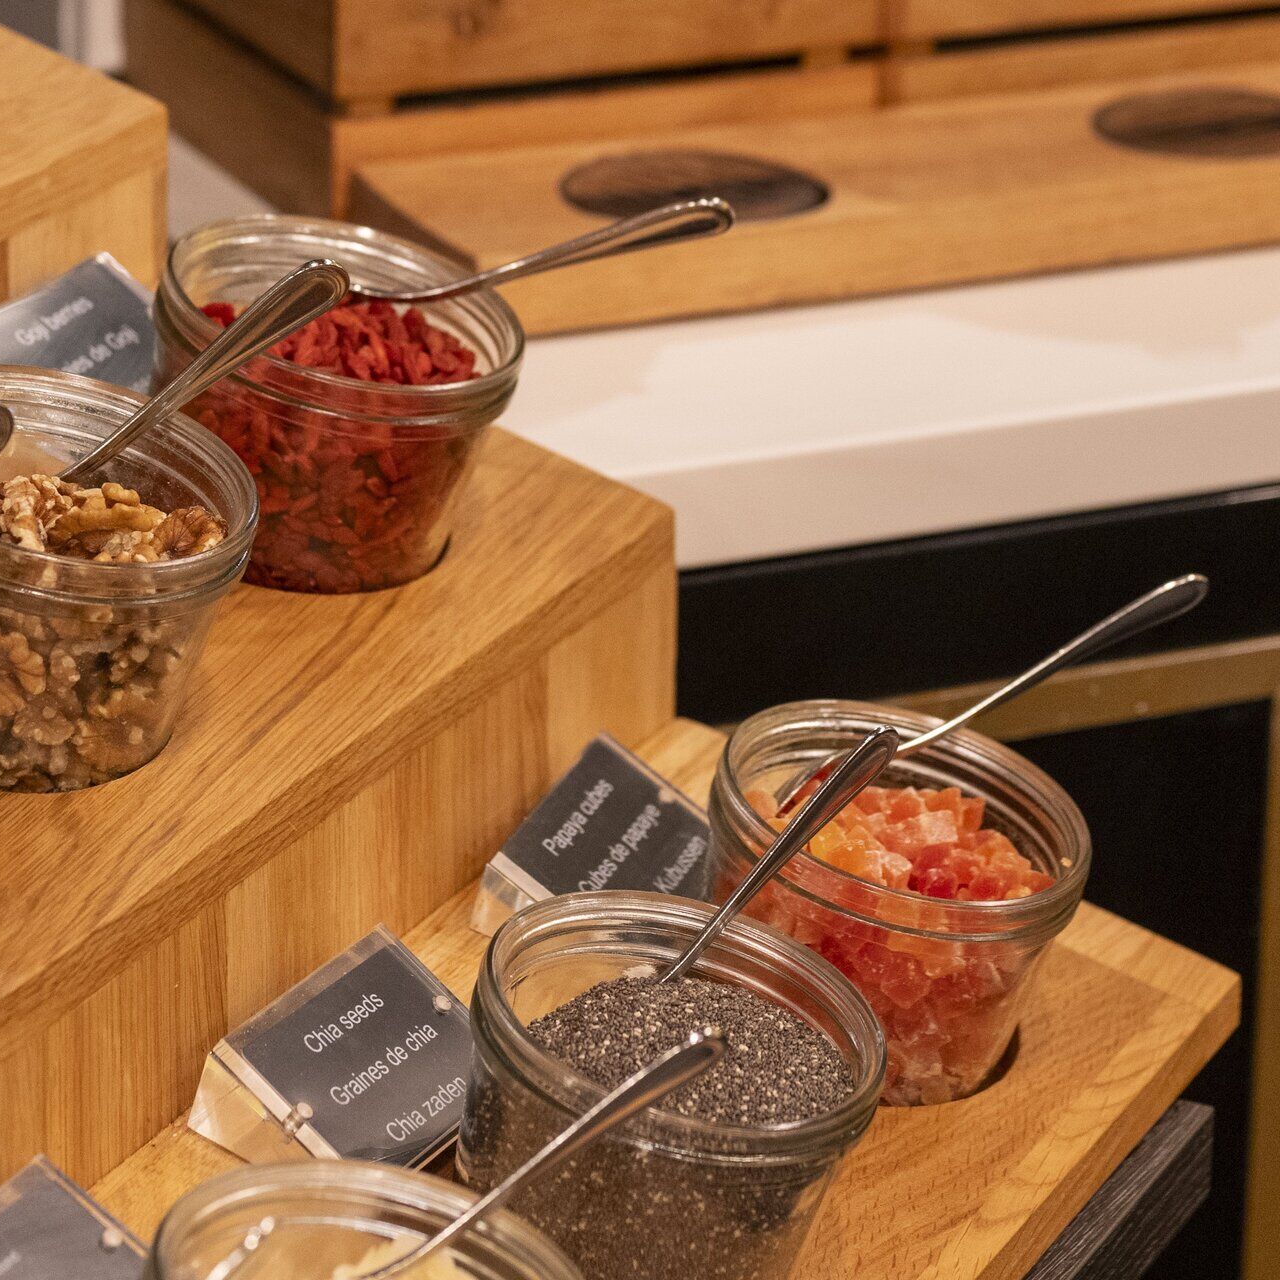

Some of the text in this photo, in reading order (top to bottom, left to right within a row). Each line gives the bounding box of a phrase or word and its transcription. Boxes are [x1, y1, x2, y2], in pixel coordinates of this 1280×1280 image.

[542, 779, 615, 856] Papaya cubes
[578, 804, 662, 892] Cubes de papaye
[303, 993, 384, 1053] Chia seeds
[330, 1024, 439, 1105] Graines de chia
[386, 1077, 466, 1141] Chia zaden
